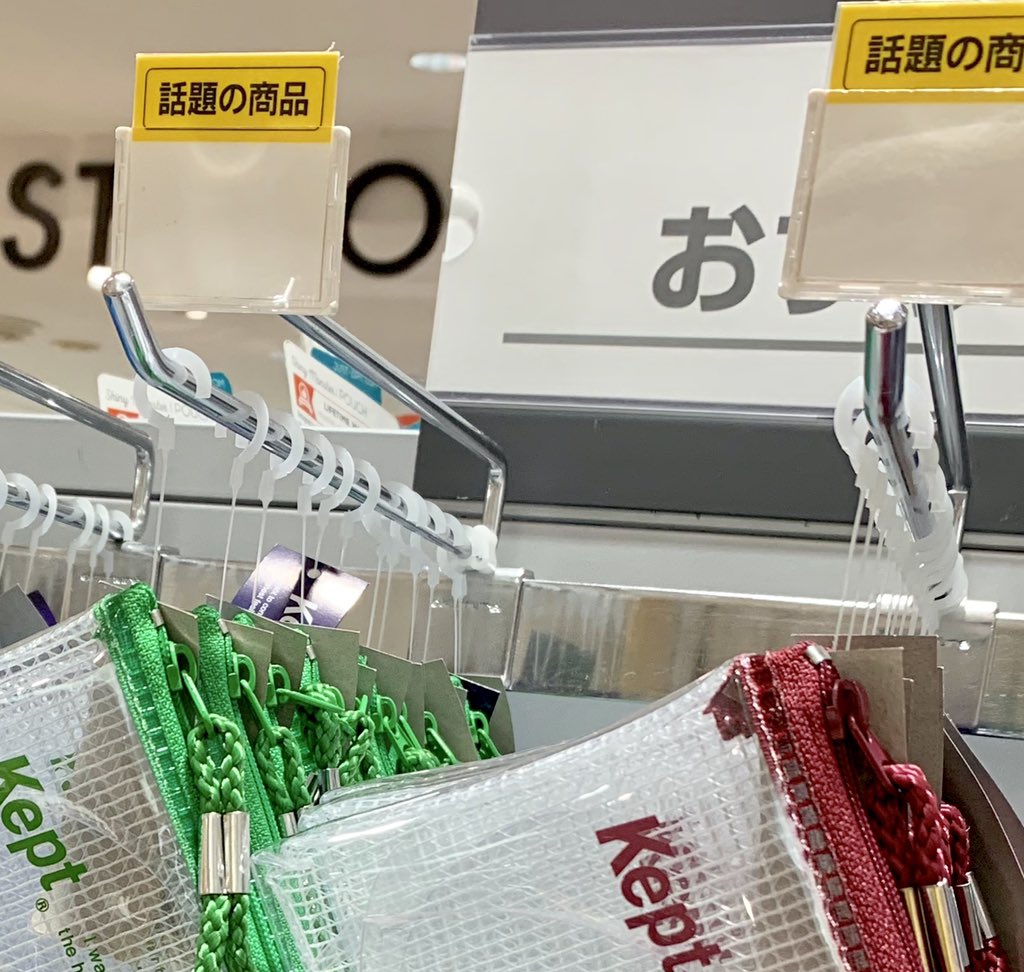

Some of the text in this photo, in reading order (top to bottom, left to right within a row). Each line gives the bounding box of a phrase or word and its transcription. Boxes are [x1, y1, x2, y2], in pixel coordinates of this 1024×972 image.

[158, 81, 310, 118] 話題の商品
[58, 927, 77, 958] the
